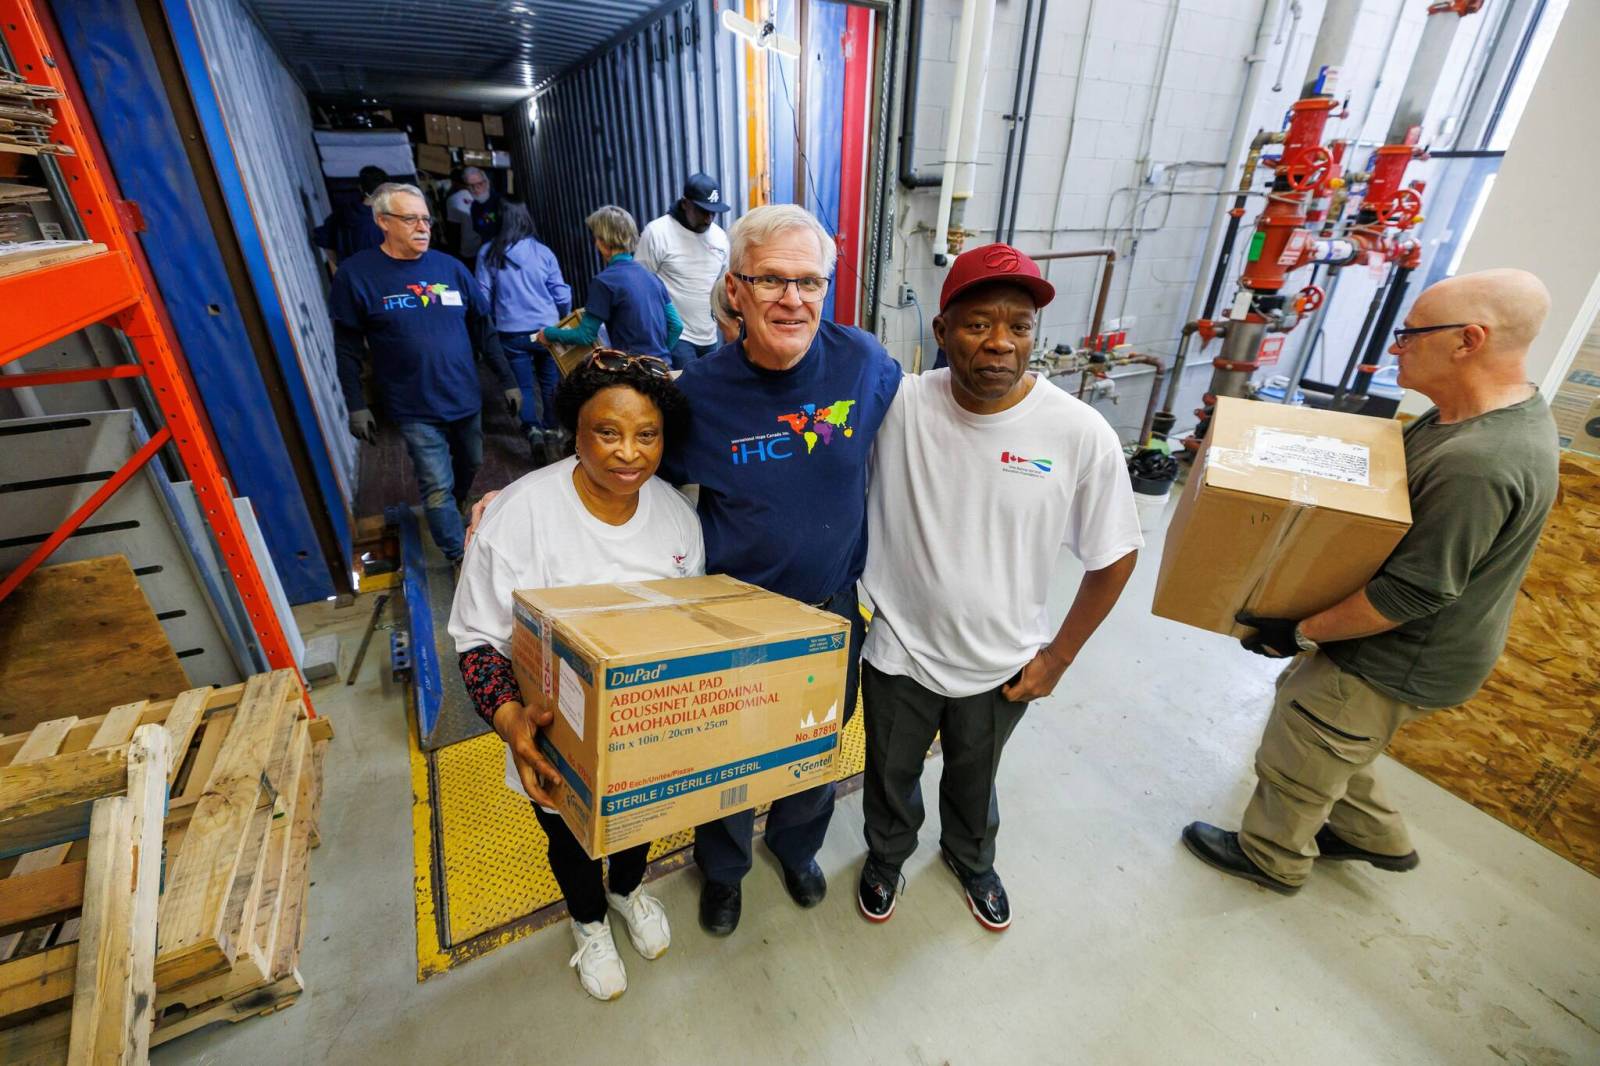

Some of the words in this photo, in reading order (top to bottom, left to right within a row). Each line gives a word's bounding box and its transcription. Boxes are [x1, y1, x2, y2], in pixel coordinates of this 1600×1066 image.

[731, 437, 793, 465] iHC
[610, 682, 695, 707] ABDOMINAL
[699, 676, 723, 690] PAD
[610, 697, 688, 723] COUSSINET
[692, 682, 765, 706] ABDOMINAL
[609, 708, 707, 738] ALMOHADILLA
[710, 692, 780, 717] ABDOMINAL
[608, 742, 625, 753] 8in
[628, 740, 634, 748] x
[638, 734, 659, 746] 10in
[668, 726, 694, 739] 20cm
[704, 719, 728, 731] 25cm
[795, 732, 811, 743] No.
[801, 754, 833, 772] Gentell
[606, 789, 657, 813] STERILE
[667, 774, 713, 796] STÉRILE
[720, 761, 762, 780] ESTÉRIL
[607, 781, 628, 794] 200
